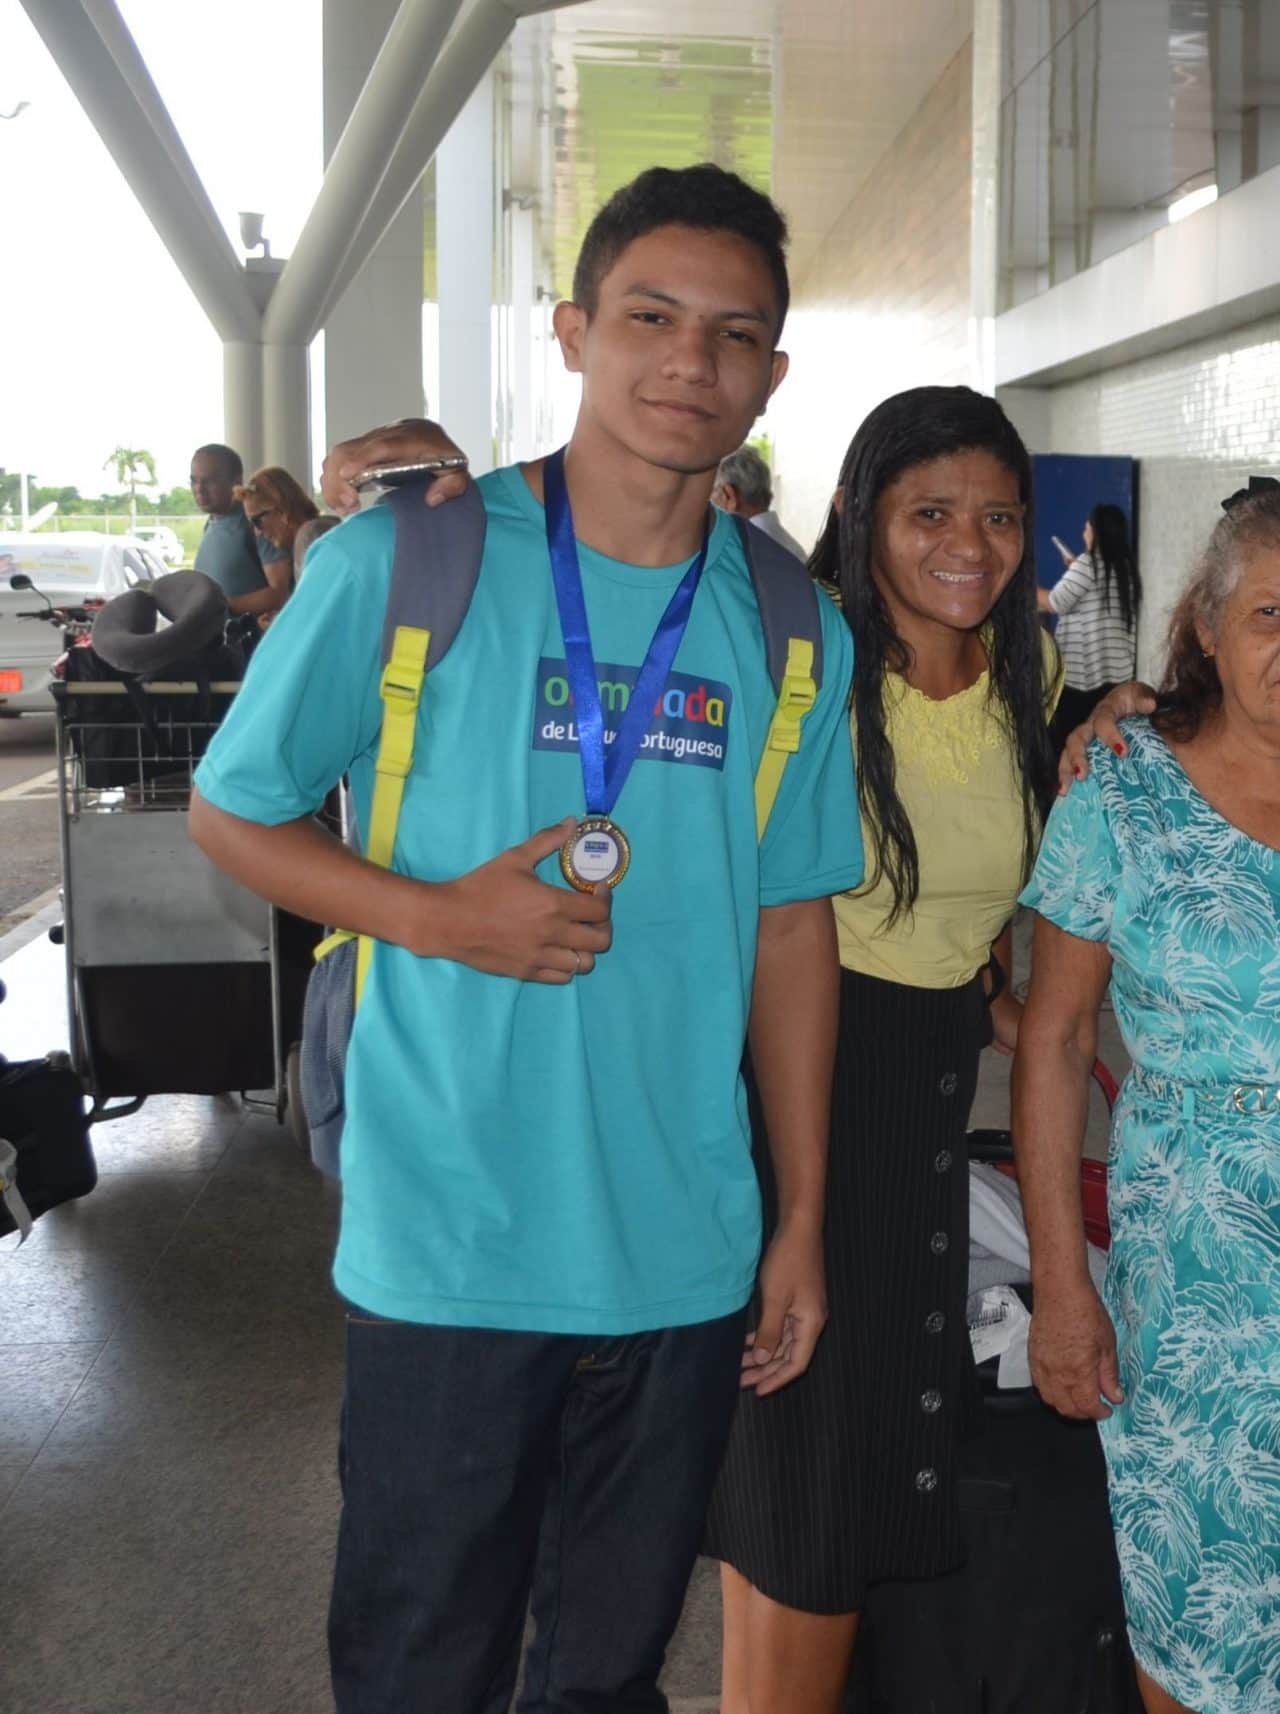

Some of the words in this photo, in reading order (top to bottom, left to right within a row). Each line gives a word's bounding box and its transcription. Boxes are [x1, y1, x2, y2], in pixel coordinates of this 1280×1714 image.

[544, 676, 725, 727] omada
[542, 720, 565, 740] de
[639, 731, 723, 758] ortuguesa
